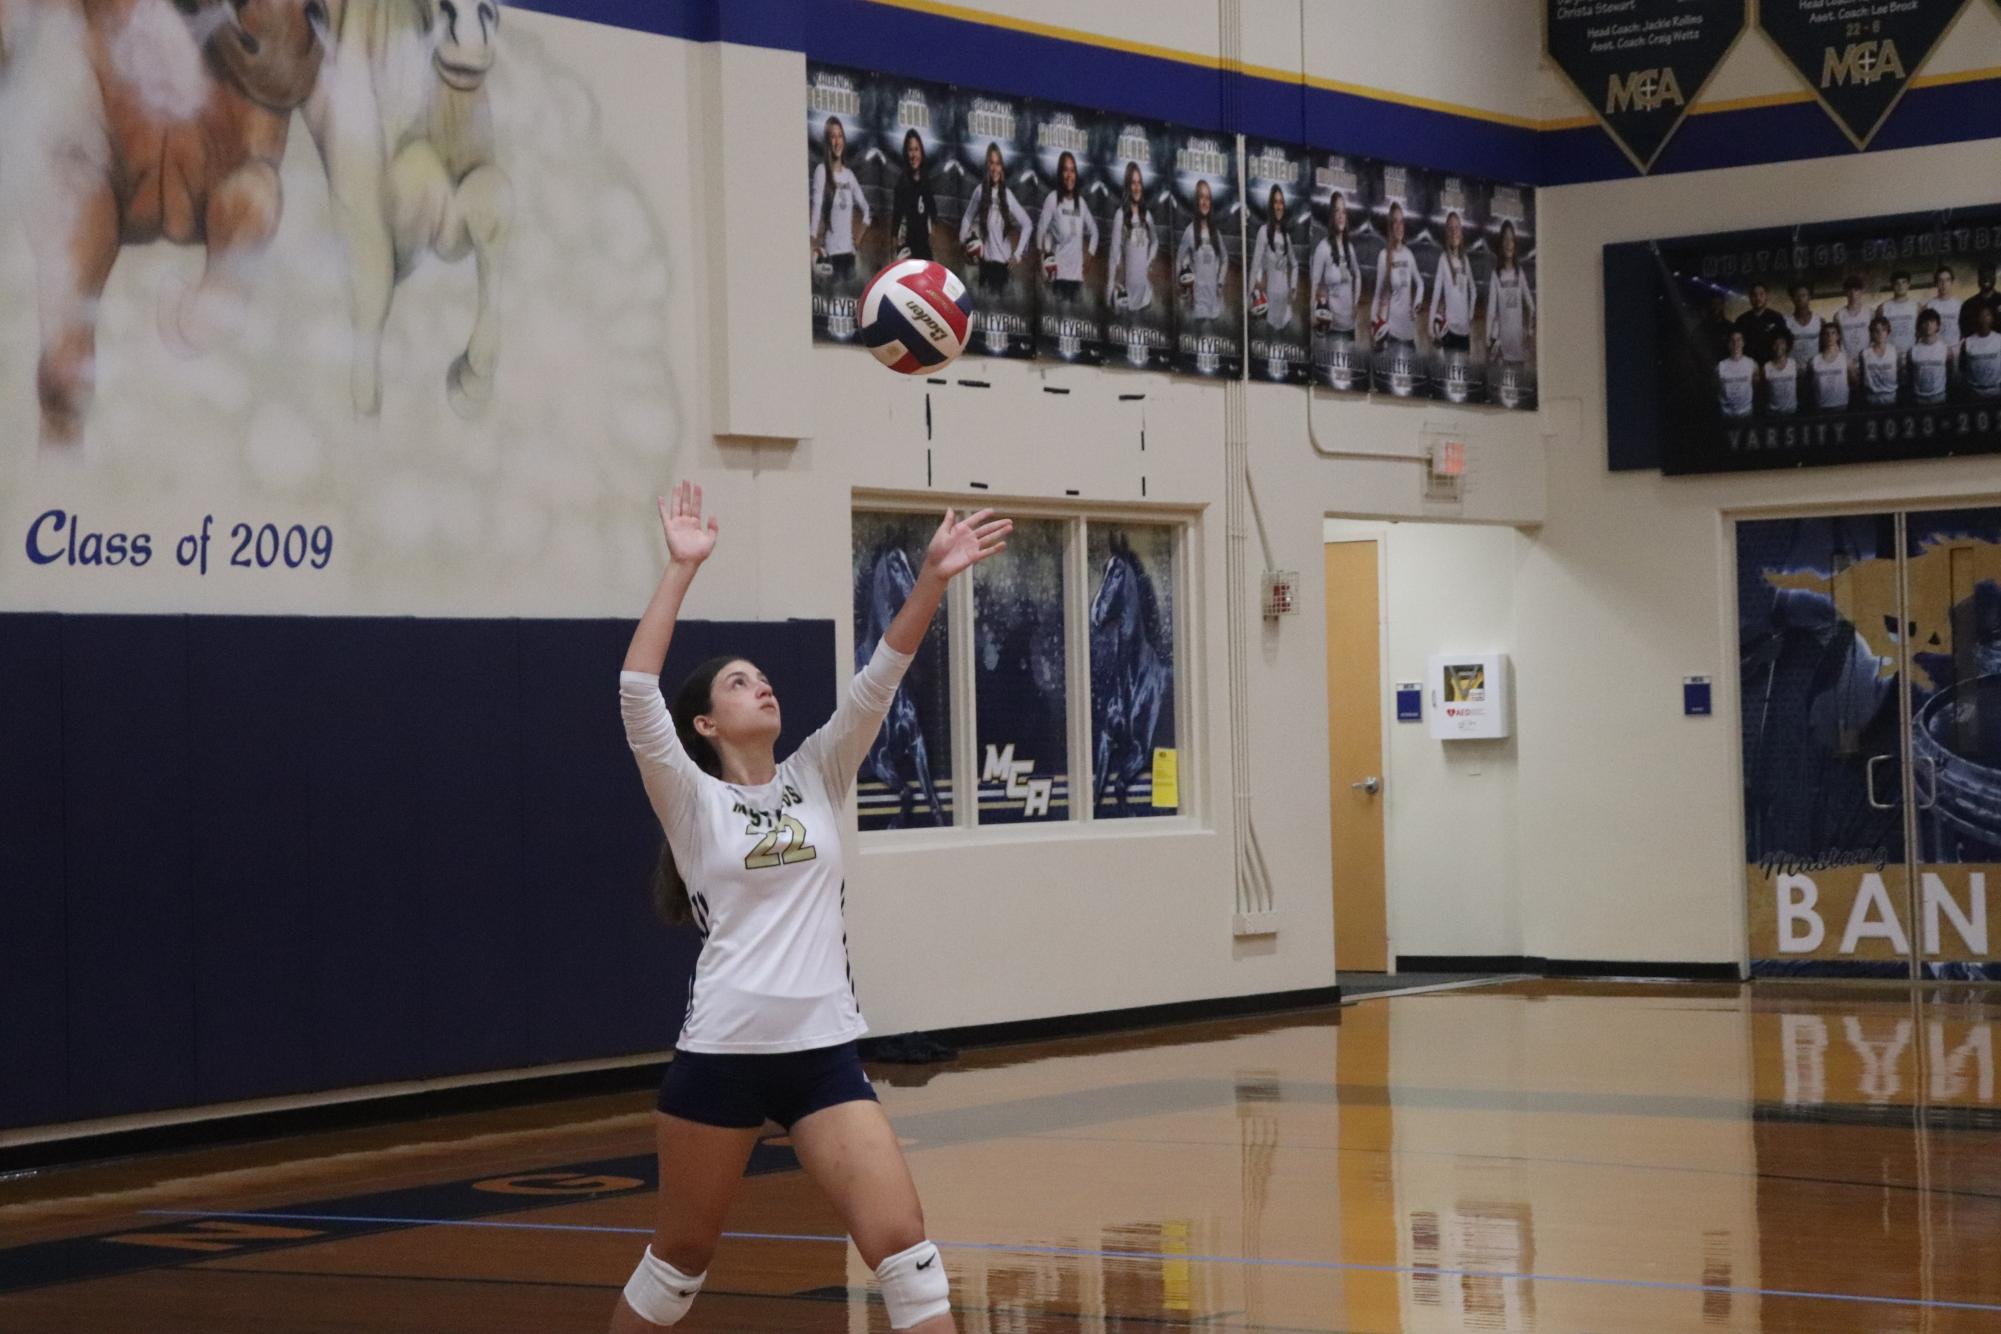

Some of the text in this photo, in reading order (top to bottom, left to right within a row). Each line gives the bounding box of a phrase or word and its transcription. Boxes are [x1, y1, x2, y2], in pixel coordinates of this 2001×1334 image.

[1821, 39, 1907, 89] MCA
[1605, 67, 1686, 114] MCA
[905, 300, 949, 342] Baden
[1729, 421, 1847, 452] VARSITY
[25, 508, 334, 576] Class of 2009
[982, 743, 1053, 817] MCA
[744, 813, 817, 870] 22
[1757, 846, 1889, 881] Mustang
[1776, 871, 1989, 955] BAN
